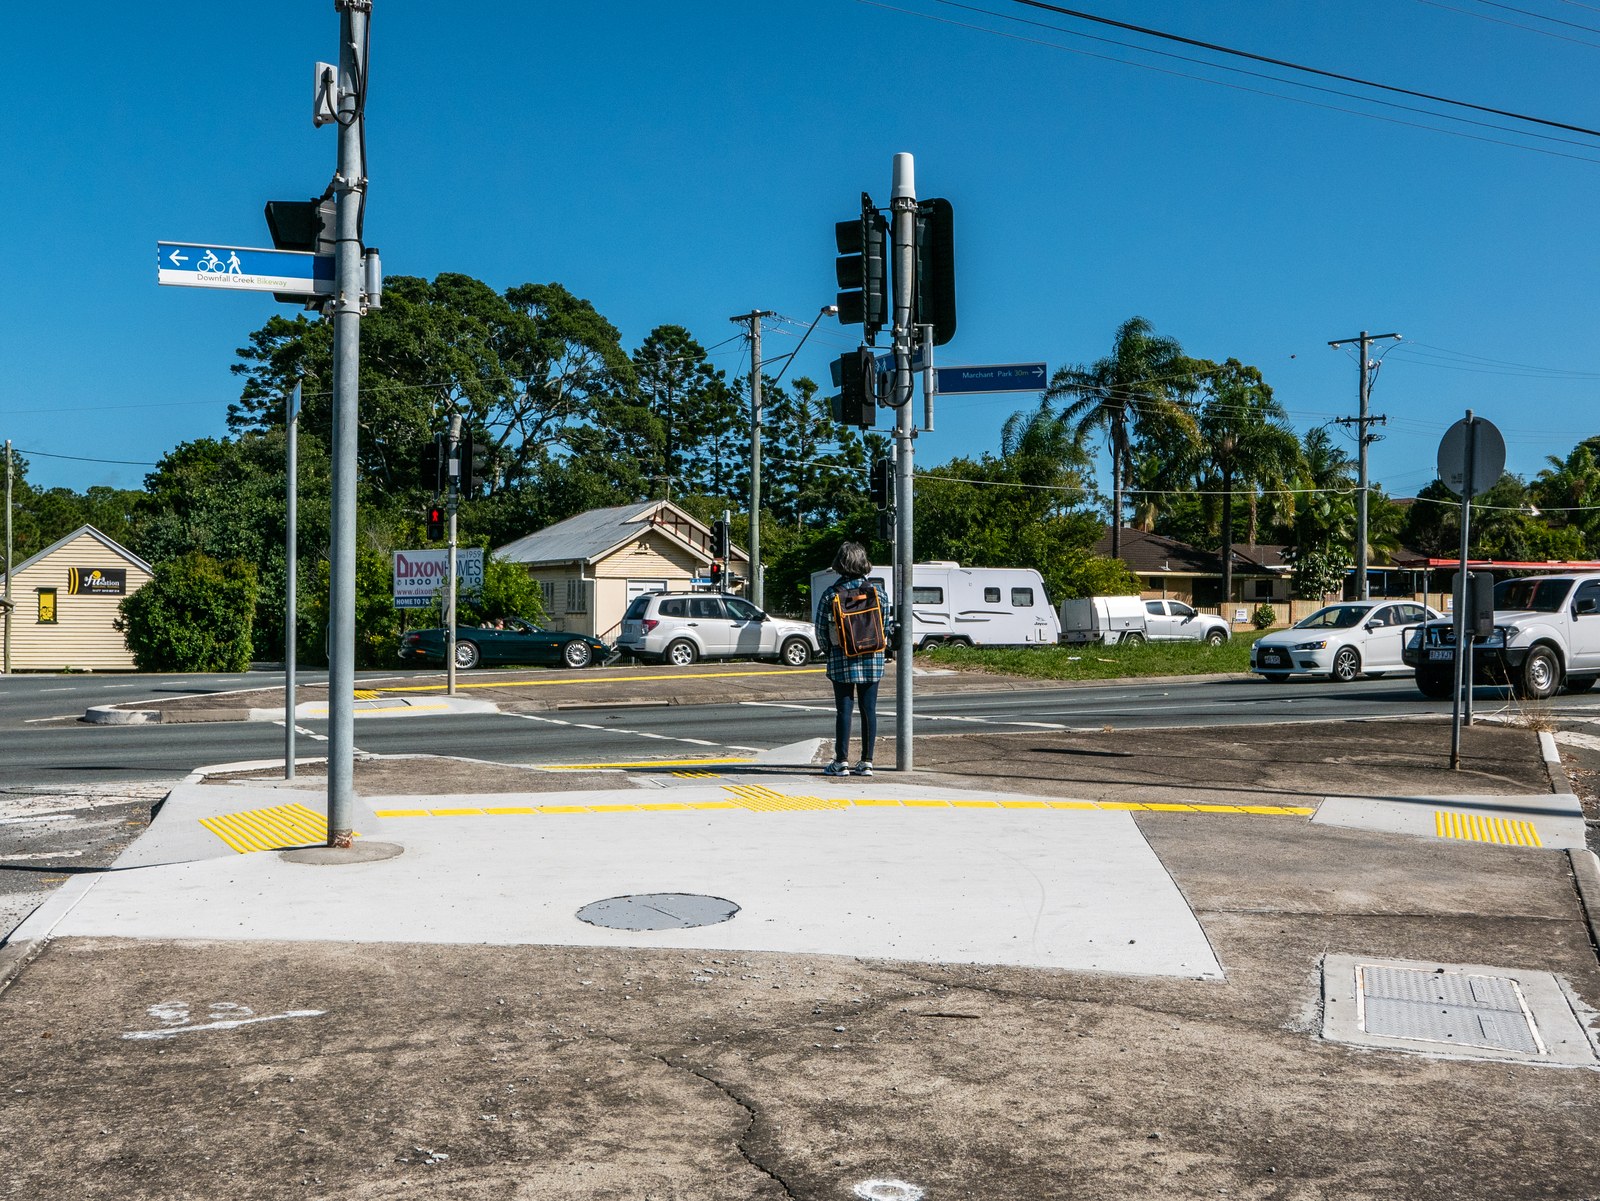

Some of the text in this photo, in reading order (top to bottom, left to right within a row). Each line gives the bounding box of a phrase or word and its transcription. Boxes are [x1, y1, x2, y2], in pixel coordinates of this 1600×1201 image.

[197, 273, 288, 288] Downfall Creek Bikeway
[962, 371, 994, 379] Marchant
[466, 550, 482, 559] 1959
[404, 578, 432, 586] 1300
[396, 598, 413, 606] HOME
